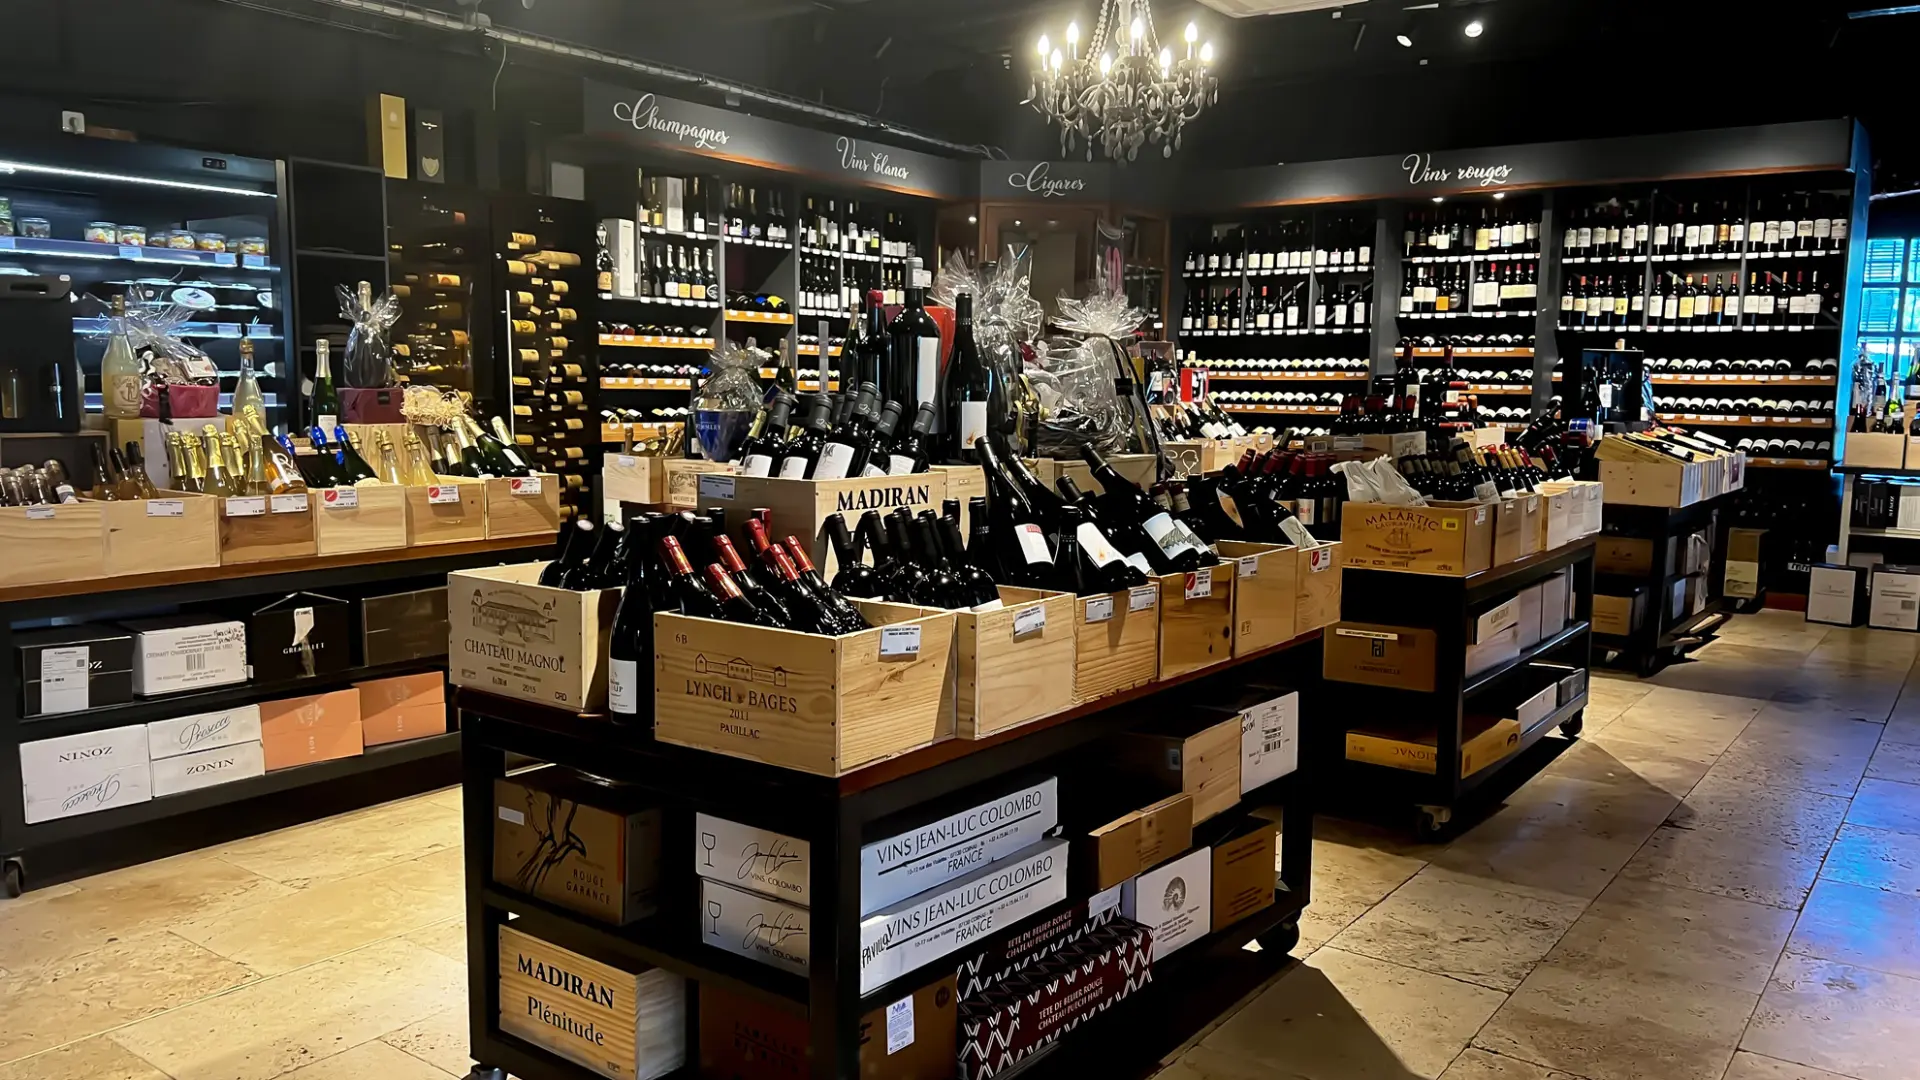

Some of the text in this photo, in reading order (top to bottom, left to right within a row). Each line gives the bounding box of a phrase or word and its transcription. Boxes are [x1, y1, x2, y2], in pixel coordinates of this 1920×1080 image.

[613, 93, 730, 149] Champagnes
[836, 136, 911, 180] Vins blancs
[1402, 153, 1513, 187] Vins rouges
[1008, 161, 1087, 198] Cigares
[836, 485, 930, 511] MADIRAN
[1365, 511, 1440, 532] MALARTIC
[675, 633, 688, 644] 6B
[464, 638, 566, 674] CHATEAU MAGNOL
[686, 679, 797, 714] LYNCH BAGES
[729, 708, 749, 721] 2011
[179, 715, 231, 750] Prosecco
[719, 723, 761, 740] PAUILLAC
[58, 746, 113, 763] ZONIN
[186, 758, 235, 776] ZONIN
[61, 773, 121, 813] Prosecco
[876, 790, 1042, 864] VINS JEAN-LUC COLOMBO
[947, 847, 984, 873] FRANCE
[573, 868, 605, 888] ROUGE
[750, 872, 803, 894] VINS COLOMBO
[566, 881, 610, 905] GARANCE
[886, 855, 1053, 938] VINS JEAN-LUC COLOMBO
[955, 916, 993, 944] FRANCE
[1052, 910, 1072, 927] ROUGE
[1055, 919, 1072, 933] HAUT
[756, 943, 807, 966] VINS COLOMBO
[517, 953, 615, 1010] MADIRAN
[1054, 1001, 1063, 1012] DE
[1083, 976, 1103, 994] ROUGE
[1067, 997, 1087, 1014] PUECH
[1087, 986, 1104, 1003] HAUT
[527, 995, 605, 1046] Plénitude
